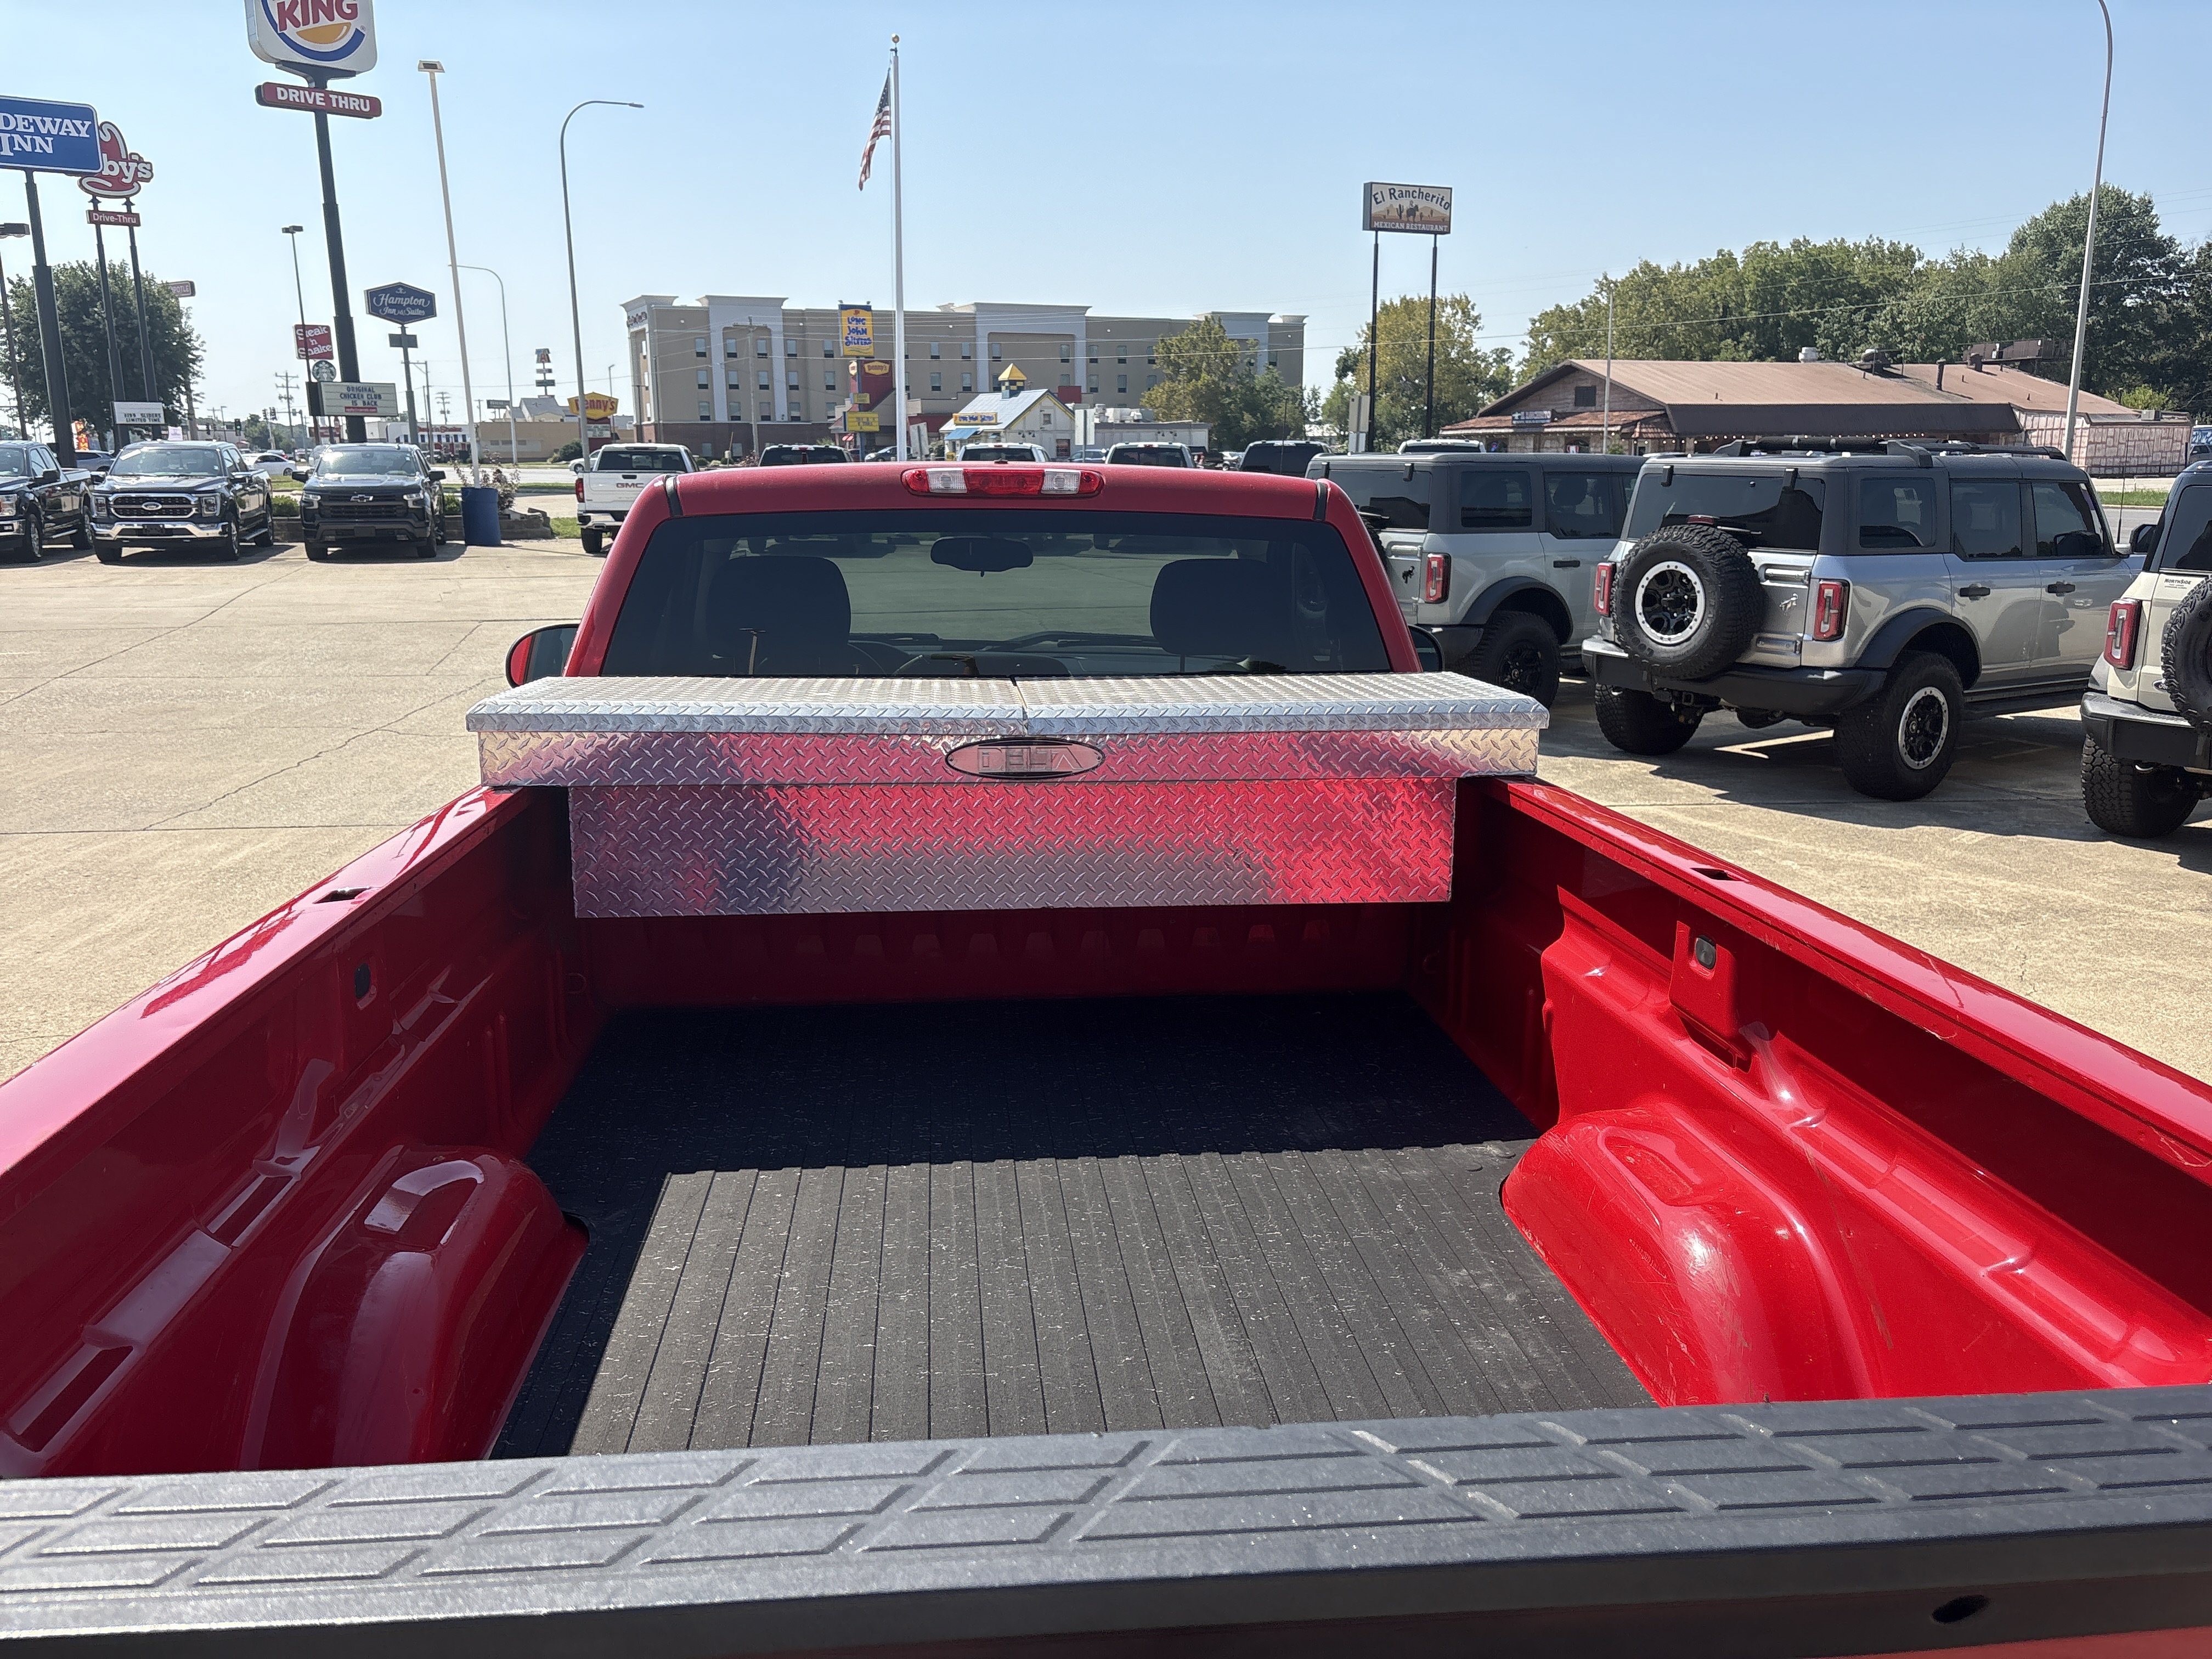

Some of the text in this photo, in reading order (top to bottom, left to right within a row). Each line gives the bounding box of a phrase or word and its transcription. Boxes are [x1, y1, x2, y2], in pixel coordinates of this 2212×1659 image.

[277, 0, 358, 32] KING
[276, 87, 371, 112] DRIVE THRU
[0, 133, 54, 156] INN
[1373, 187, 1450, 211] El Rancherito
[92, 212, 137, 223] Drive-Thru
[1374, 221, 1449, 232] MEXICAN RESTAURANT
[373, 294, 430, 307] Hampton
[379, 307, 399, 315] Inn
[977, 747, 1083, 771] DELTA
